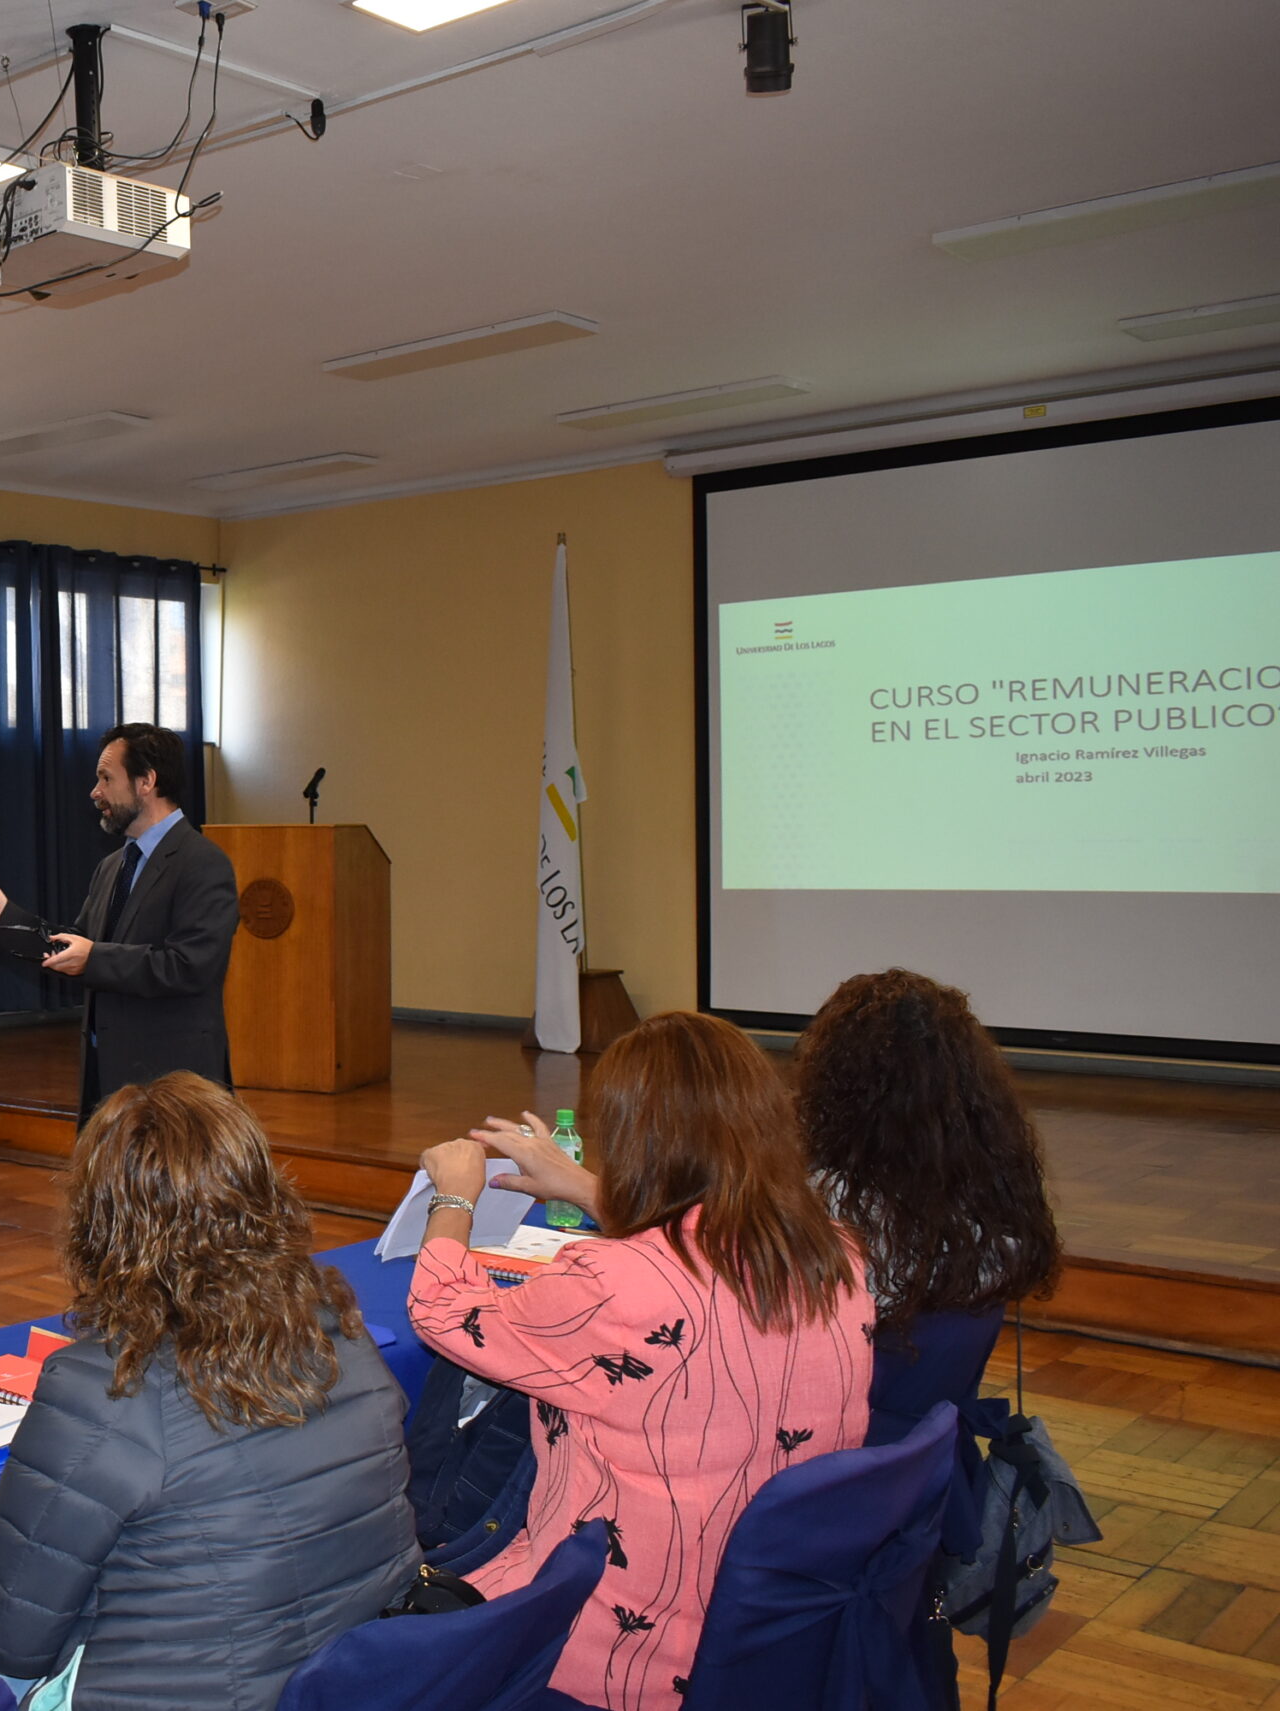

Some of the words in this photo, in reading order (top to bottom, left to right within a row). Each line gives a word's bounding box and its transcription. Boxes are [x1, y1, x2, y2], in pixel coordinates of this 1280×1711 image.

[736, 645, 782, 655] UNIVERSIDAD
[784, 642, 793, 651] DE
[795, 641, 810, 650] LOS
[811, 640, 836, 649] LAGOS
[870, 683, 980, 710] CURSO
[992, 665, 1280, 702] "REMUNERACIO
[871, 720, 911, 743] EN
[924, 718, 960, 740] EL
[969, 711, 1100, 738] SECTOR
[1115, 703, 1280, 732] PUBLICO
[1016, 750, 1071, 765] Ignacio
[1075, 747, 1139, 760] Ramírez
[1143, 745, 1207, 760] Villegas
[1016, 771, 1050, 784] abril
[1055, 771, 1093, 783] 2023
[540, 870, 575, 920] LOS
